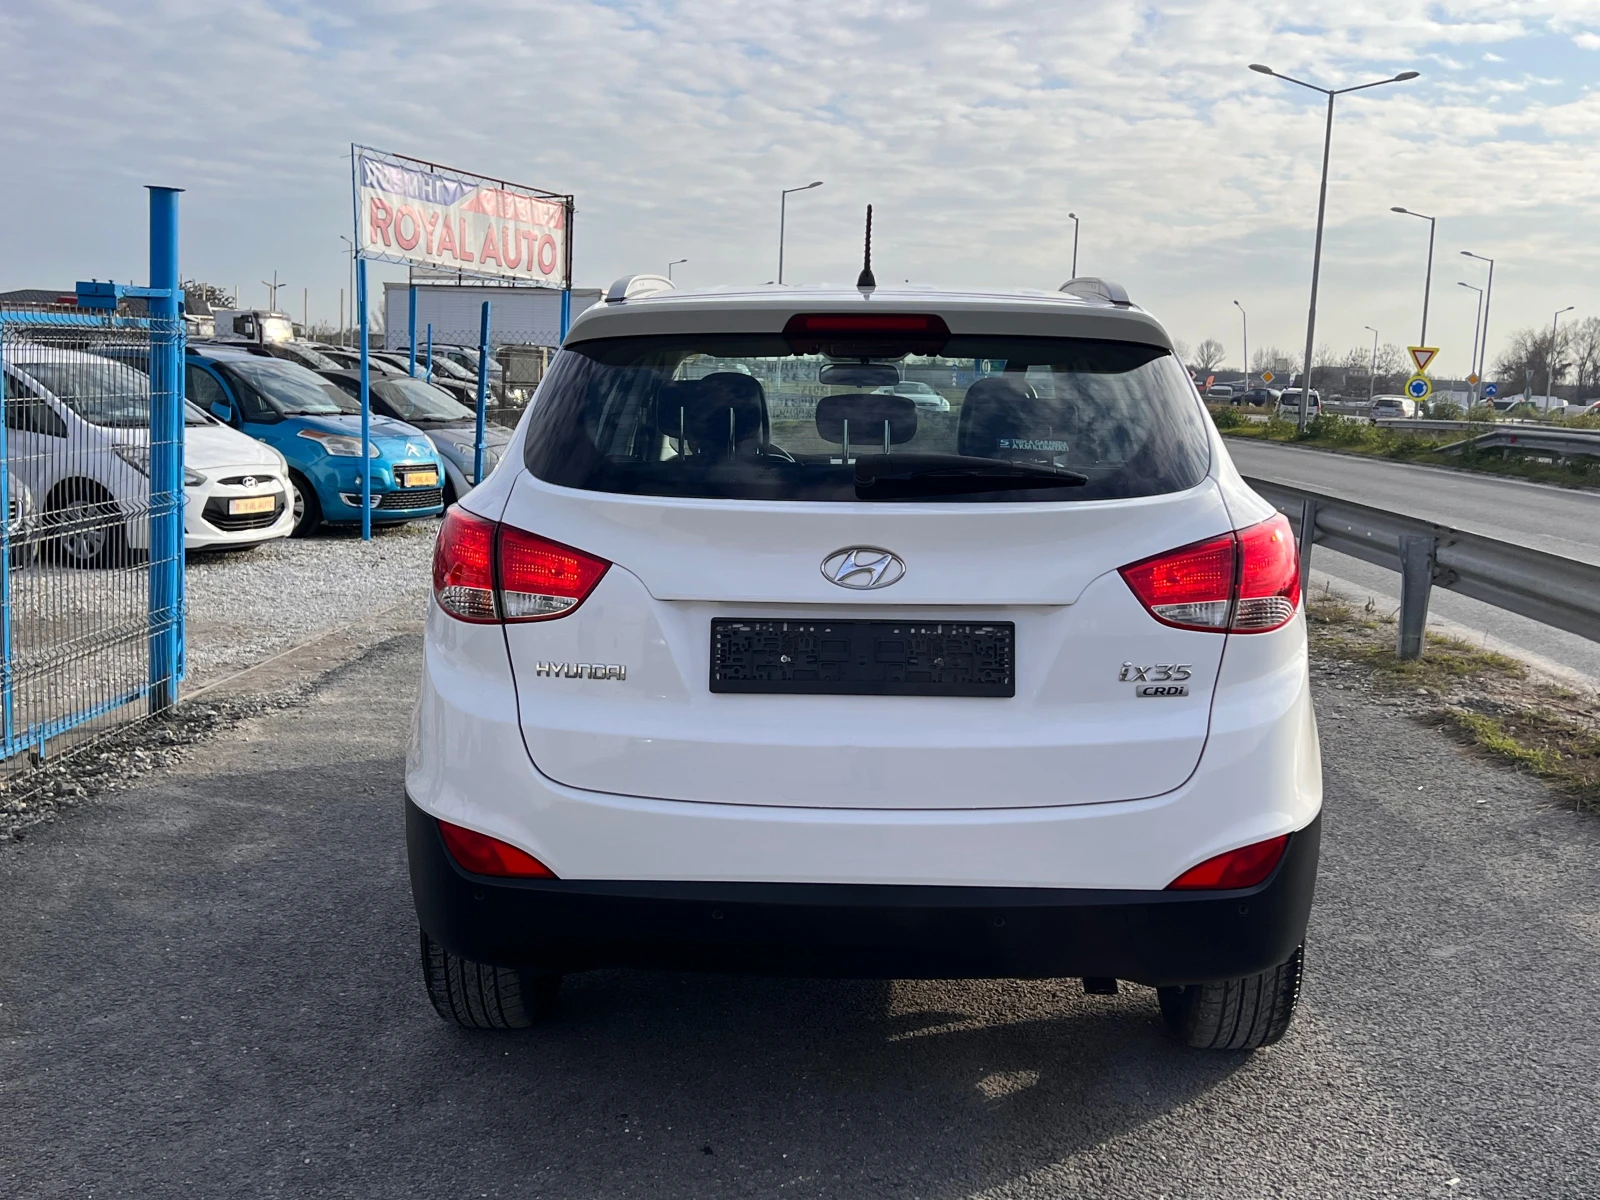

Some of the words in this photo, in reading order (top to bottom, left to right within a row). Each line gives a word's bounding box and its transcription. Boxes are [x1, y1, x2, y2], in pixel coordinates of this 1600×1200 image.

[370, 197, 475, 262] ROYAL
[480, 222, 557, 275] AUTO
[1035, 439, 1068, 447] GARANZIA
[536, 661, 627, 681] HYUNDAI
[1118, 661, 1193, 682] ix35
[1143, 686, 1184, 696] CRDi
